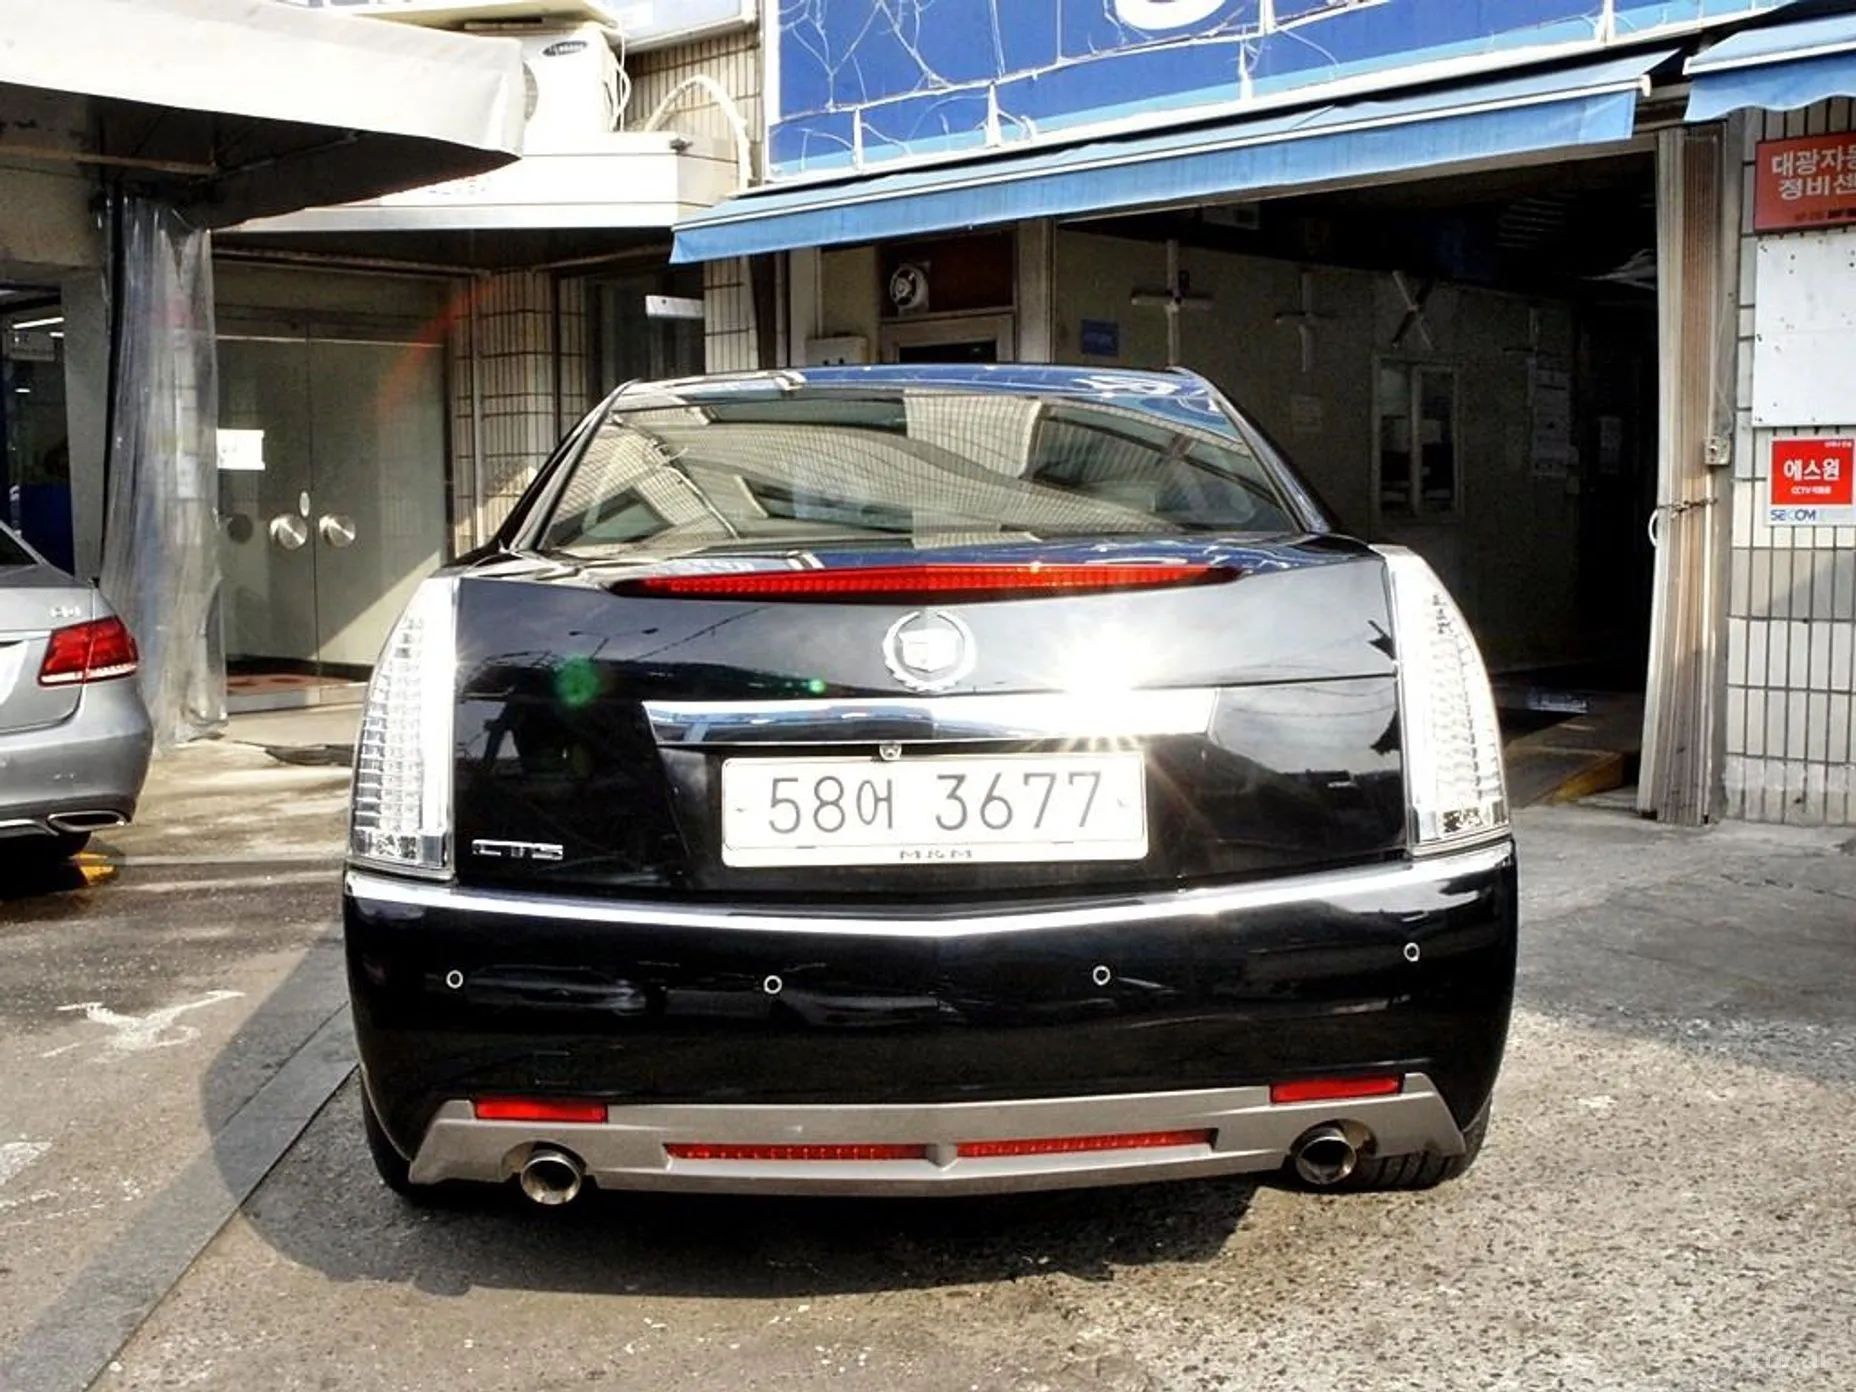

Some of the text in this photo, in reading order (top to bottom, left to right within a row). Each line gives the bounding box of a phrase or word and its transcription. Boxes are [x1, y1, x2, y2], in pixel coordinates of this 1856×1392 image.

[1783, 457, 1840, 481] 에스원
[768, 772, 1101, 834] 58어 3677
[472, 839, 563, 861] CTS
